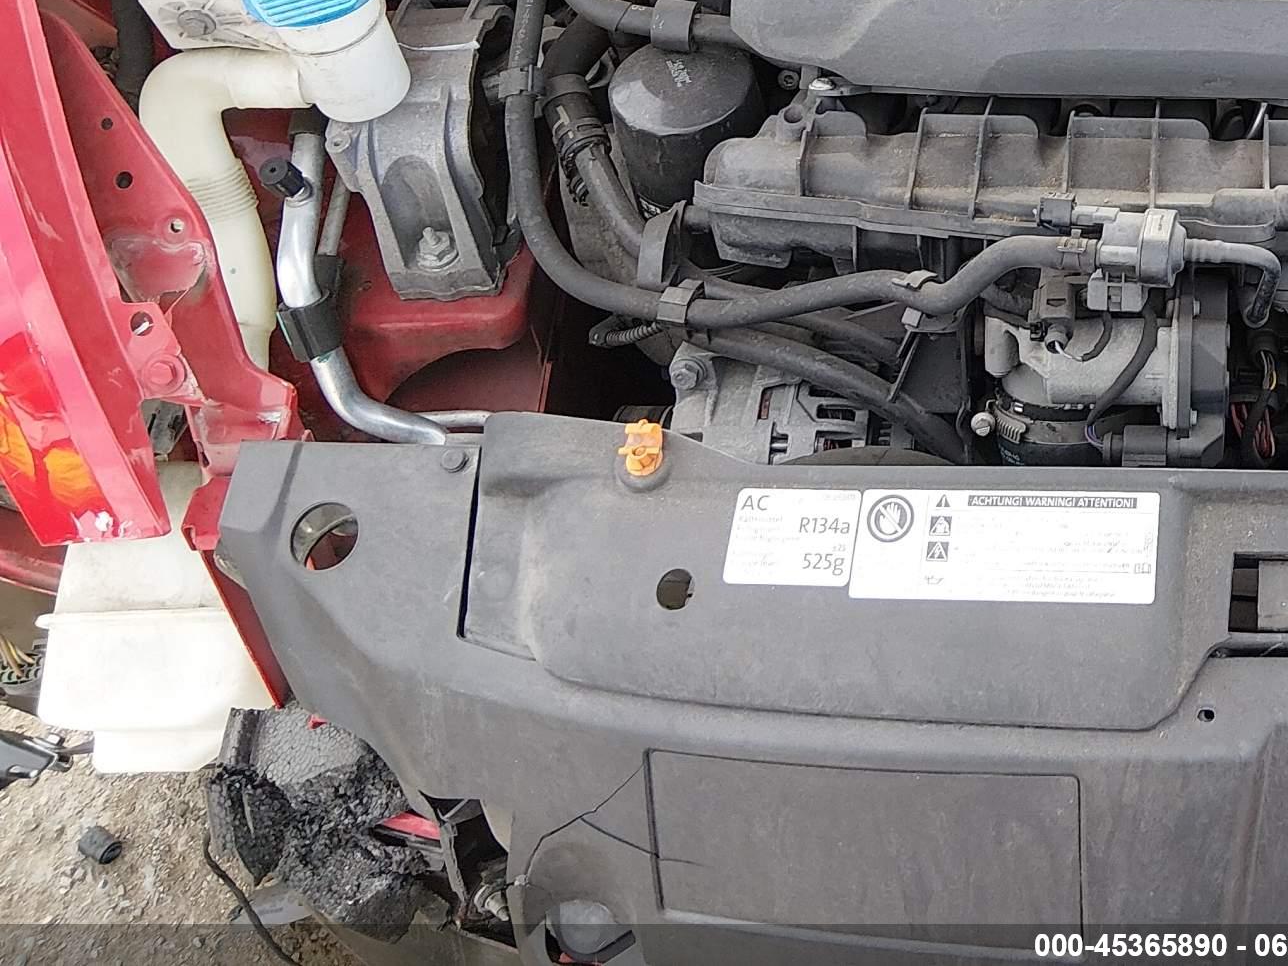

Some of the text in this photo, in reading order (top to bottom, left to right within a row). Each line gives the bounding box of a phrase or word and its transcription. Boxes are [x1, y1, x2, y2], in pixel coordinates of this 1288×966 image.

[741, 494, 770, 511] AC
[1025, 496, 1076, 508] WARNING!
[1077, 497, 1134, 509] ATTENTION!
[799, 516, 850, 534] R134a
[802, 552, 845, 576] 525g
